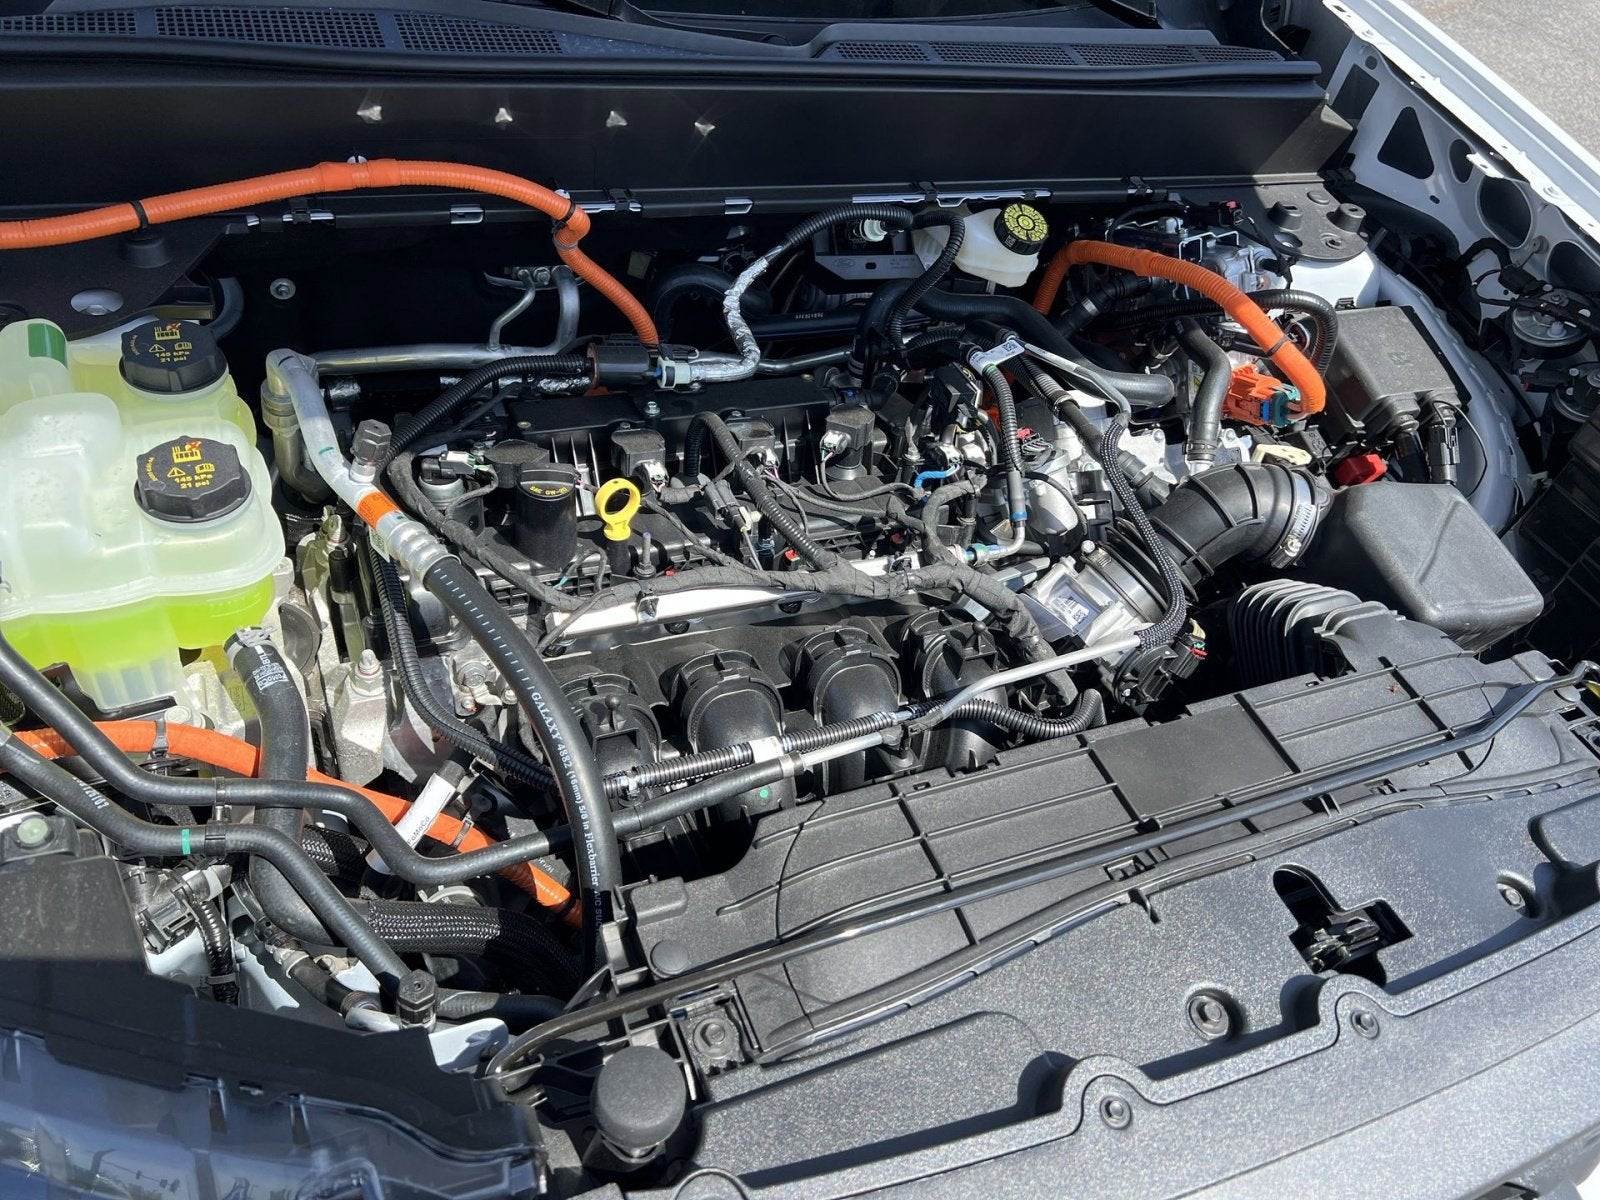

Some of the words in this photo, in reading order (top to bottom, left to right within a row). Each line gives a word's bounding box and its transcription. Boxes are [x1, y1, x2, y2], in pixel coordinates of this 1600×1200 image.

[195, 480, 209, 488] psi
[531, 692, 562, 741] GALAXY
[557, 743, 573, 769] 4882
[566, 770, 584, 804] (16mm)
[578, 805, 588, 820] 5/8
[584, 830, 600, 887] Flexbarrier
[407, 816, 430, 845] FoMoCo
